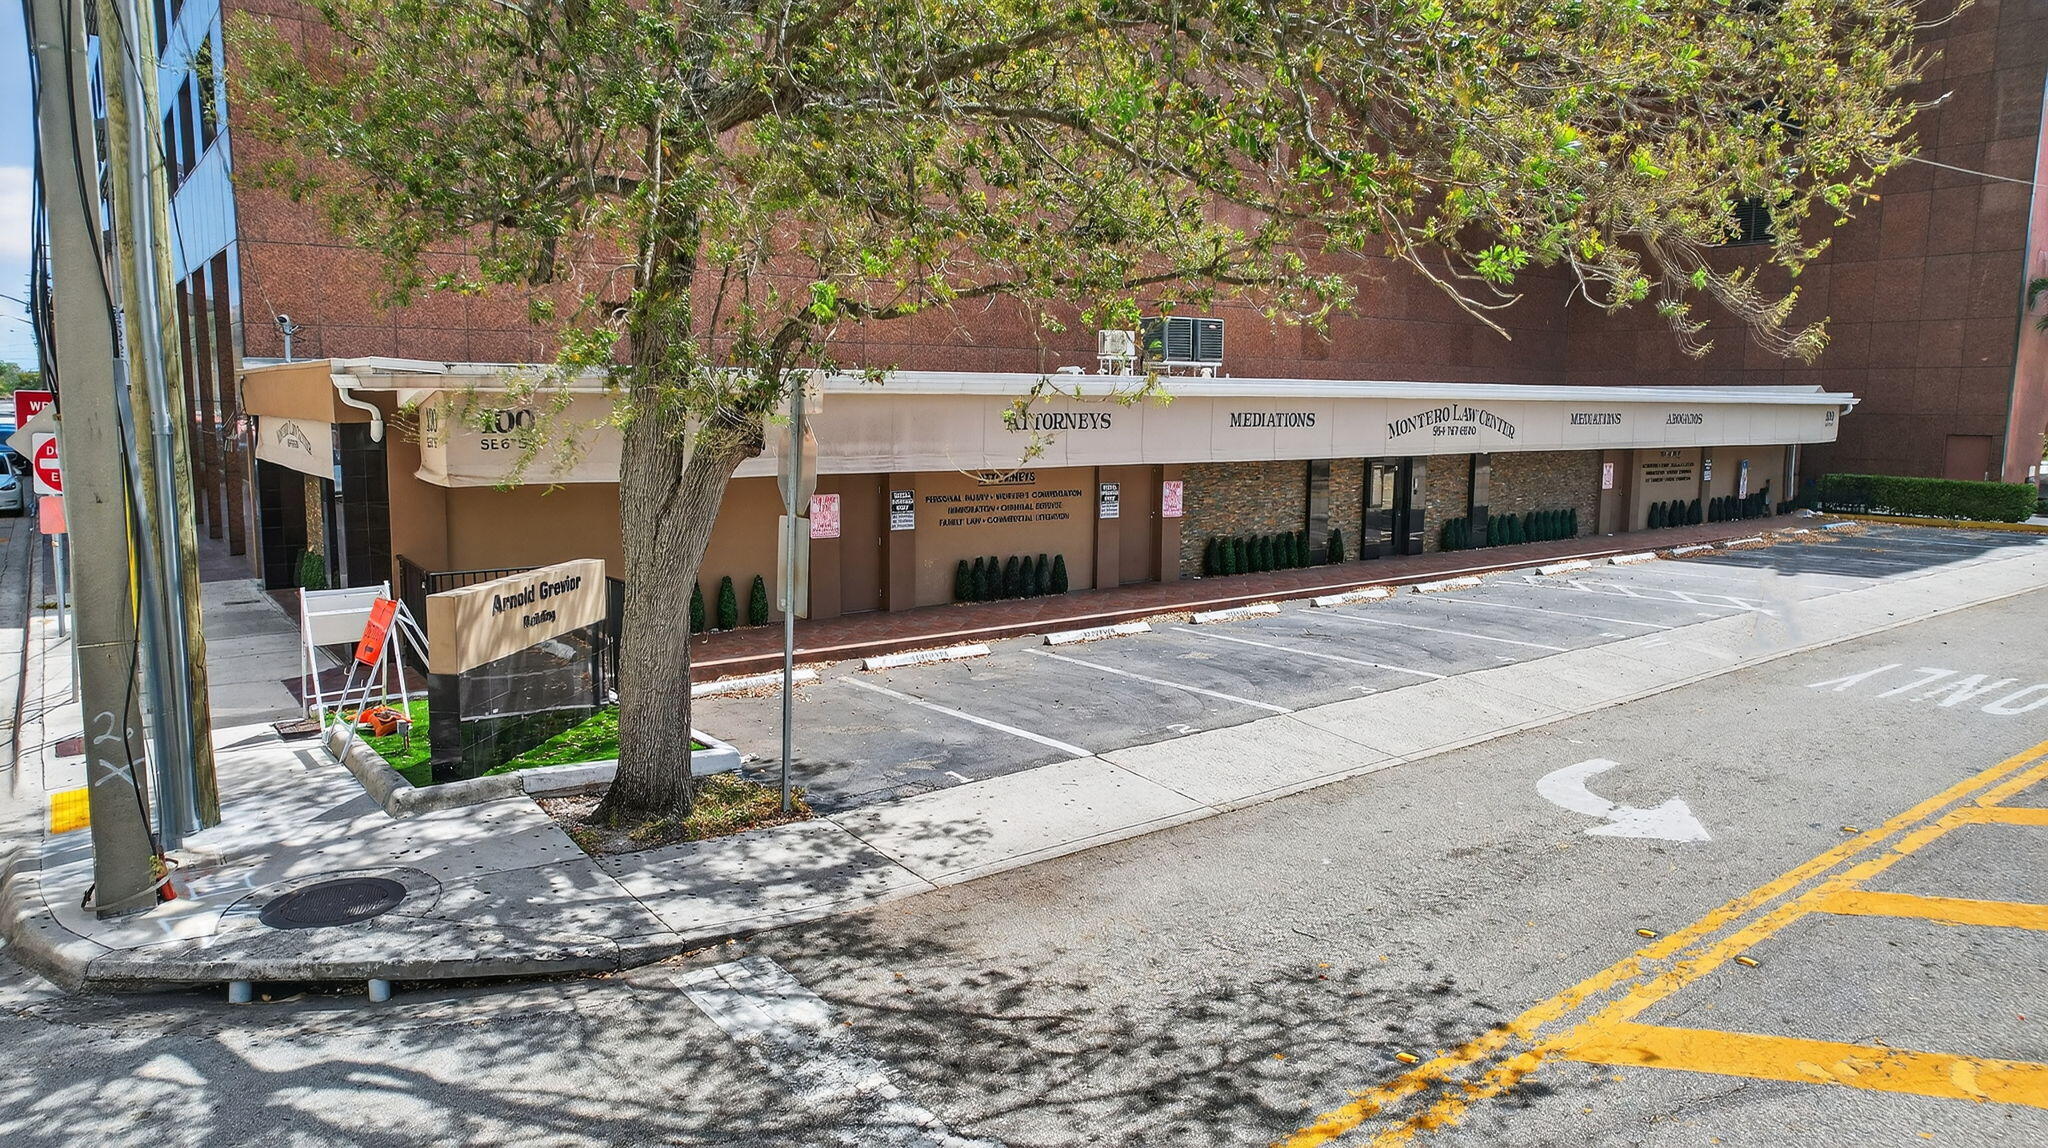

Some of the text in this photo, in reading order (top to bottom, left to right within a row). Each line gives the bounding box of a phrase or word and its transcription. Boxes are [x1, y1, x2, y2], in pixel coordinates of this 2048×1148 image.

[1003, 412, 1112, 432] ATTORNEYS
[1229, 412, 1316, 428] MEDIATIONS
[1387, 404, 1516, 440] MONTERO LAW CENTER
[480, 438, 499, 450] SE
[492, 584, 535, 616] Arnold
[523, 609, 556, 629] Building
